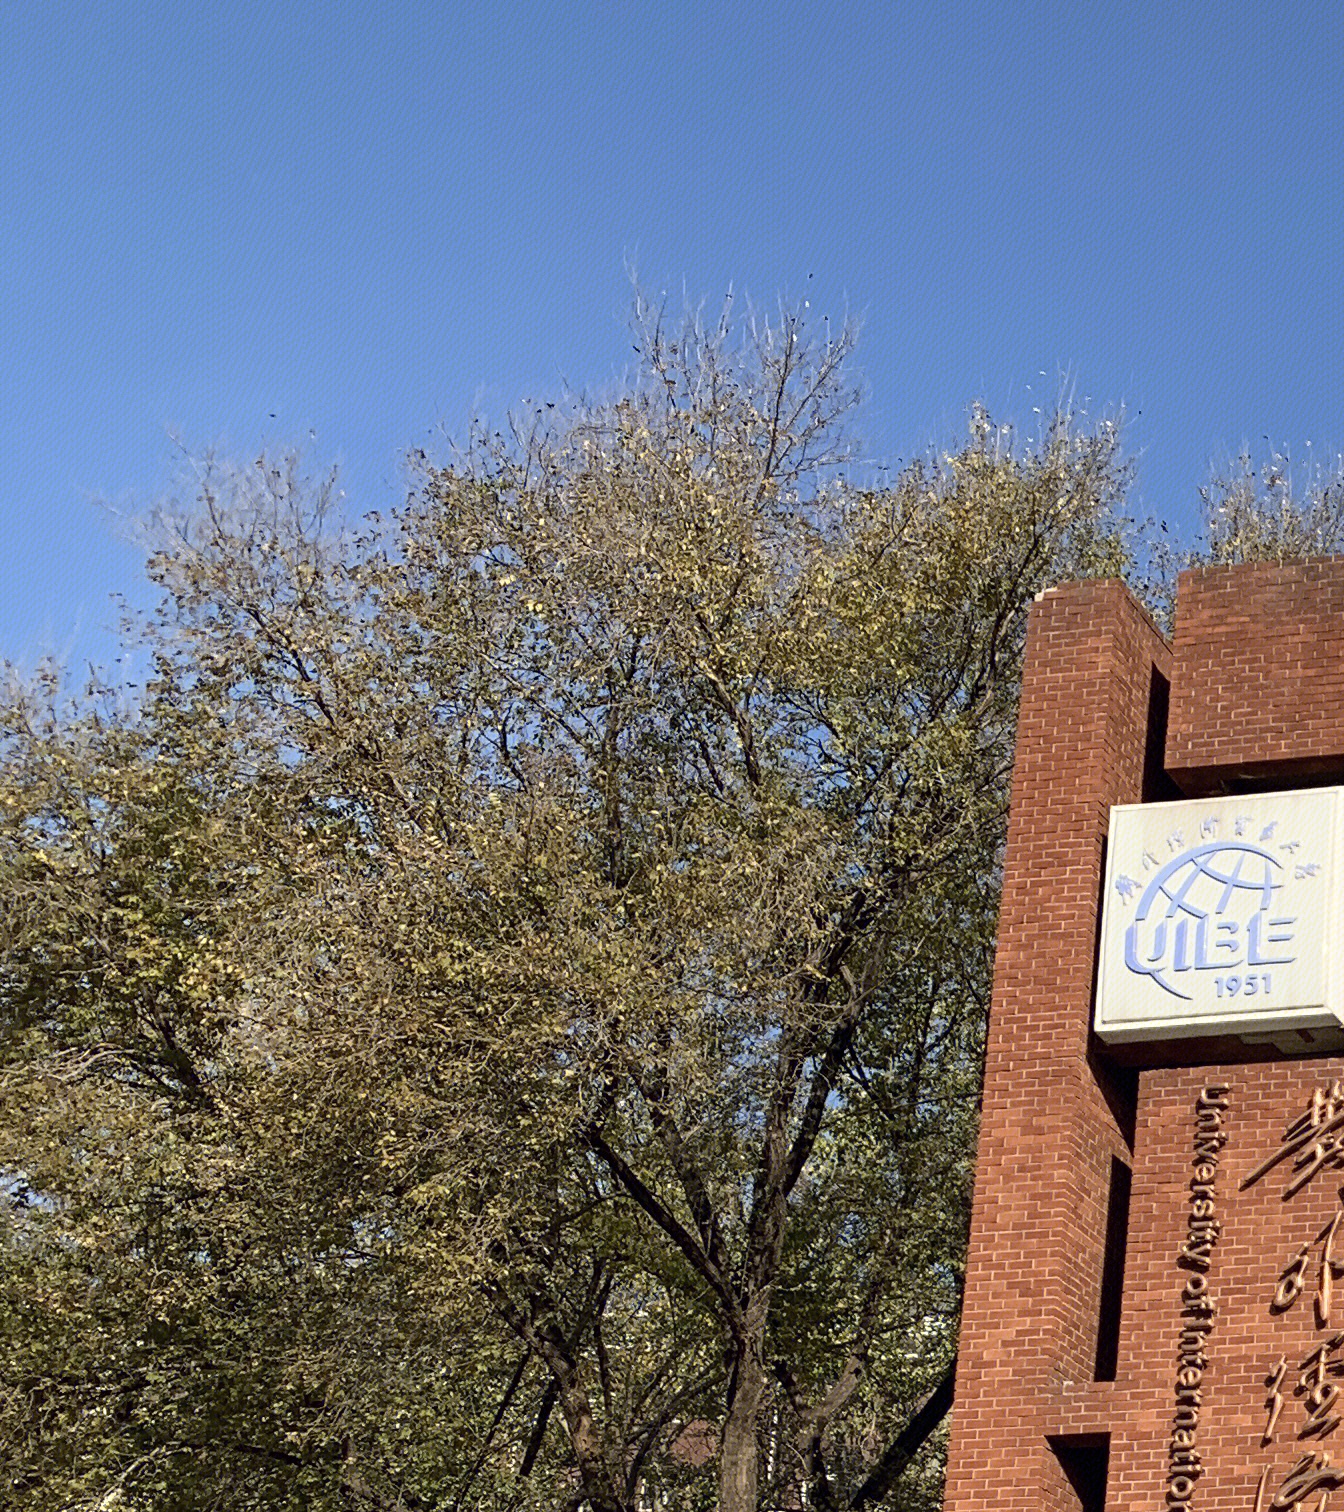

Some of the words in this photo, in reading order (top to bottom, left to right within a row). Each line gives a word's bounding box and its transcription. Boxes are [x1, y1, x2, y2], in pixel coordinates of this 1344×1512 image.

[1124, 911, 1298, 975] UIBE
[1214, 972, 1272, 998] 1951
[1181, 1082, 1231, 1269] University
[1185, 1272, 1216, 1315] of
